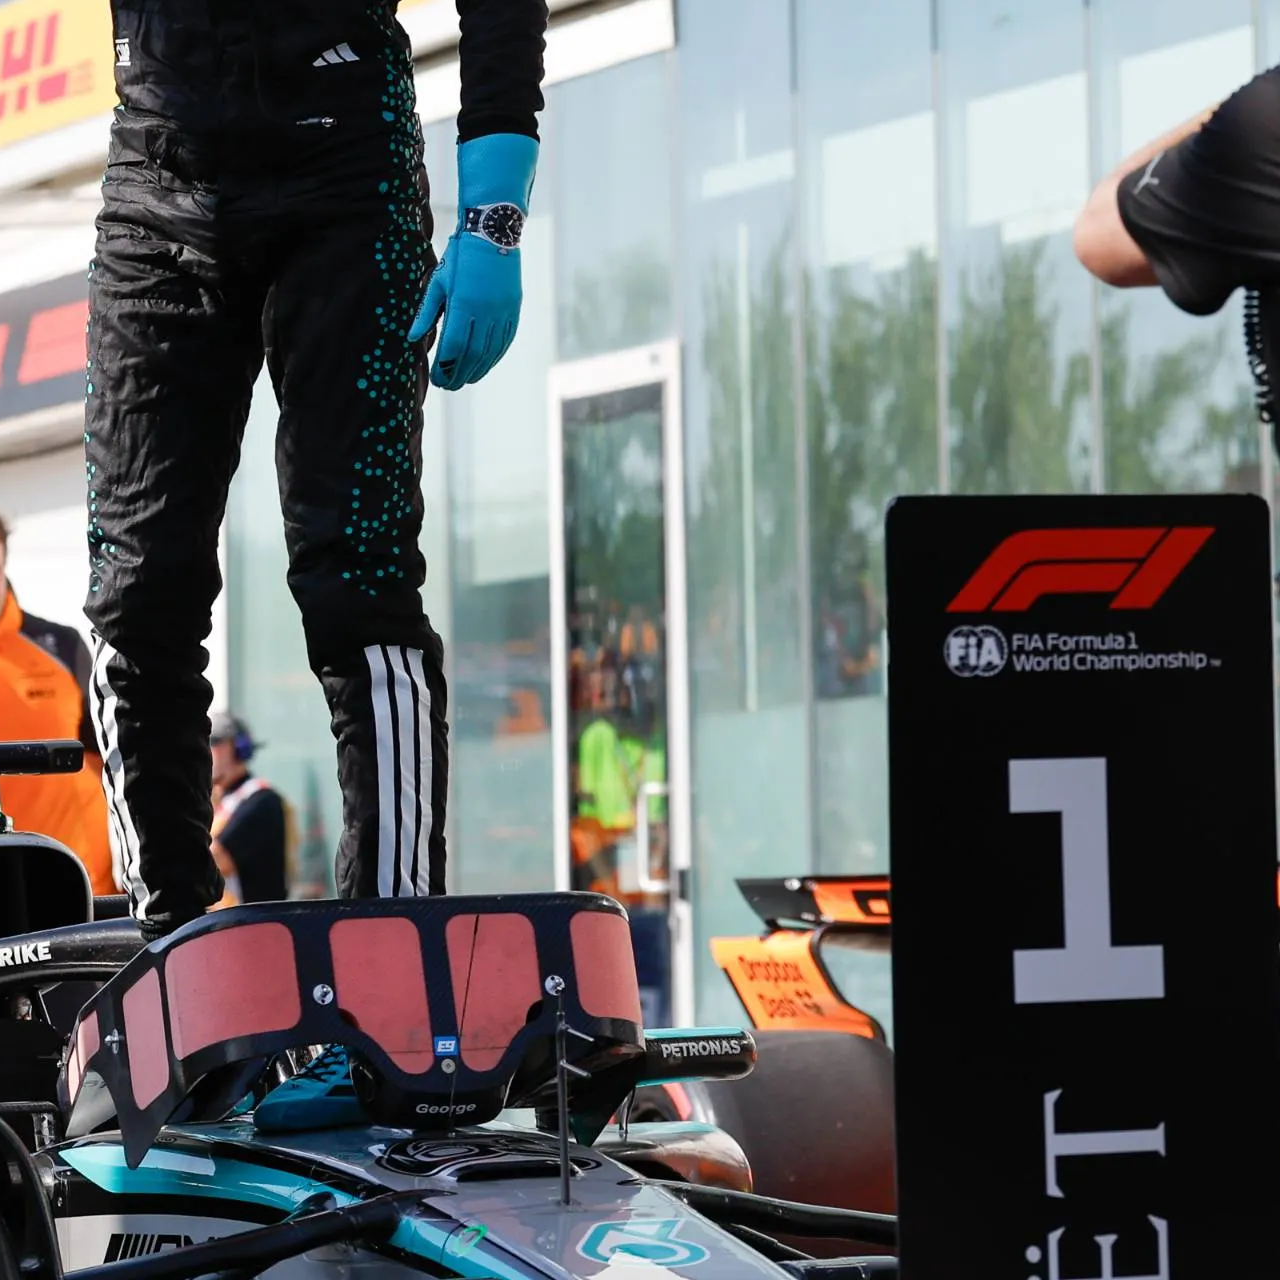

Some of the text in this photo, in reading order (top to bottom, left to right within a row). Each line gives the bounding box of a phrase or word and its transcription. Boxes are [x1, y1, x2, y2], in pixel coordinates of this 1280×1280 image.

[1012, 631, 1139, 651] FIA Formula 1
[1012, 652, 1207, 672] World Championship
[1008, 756, 1165, 1004] 1
[660, 1039, 741, 1058] PETRONAS
[415, 1103, 477, 1115] George
